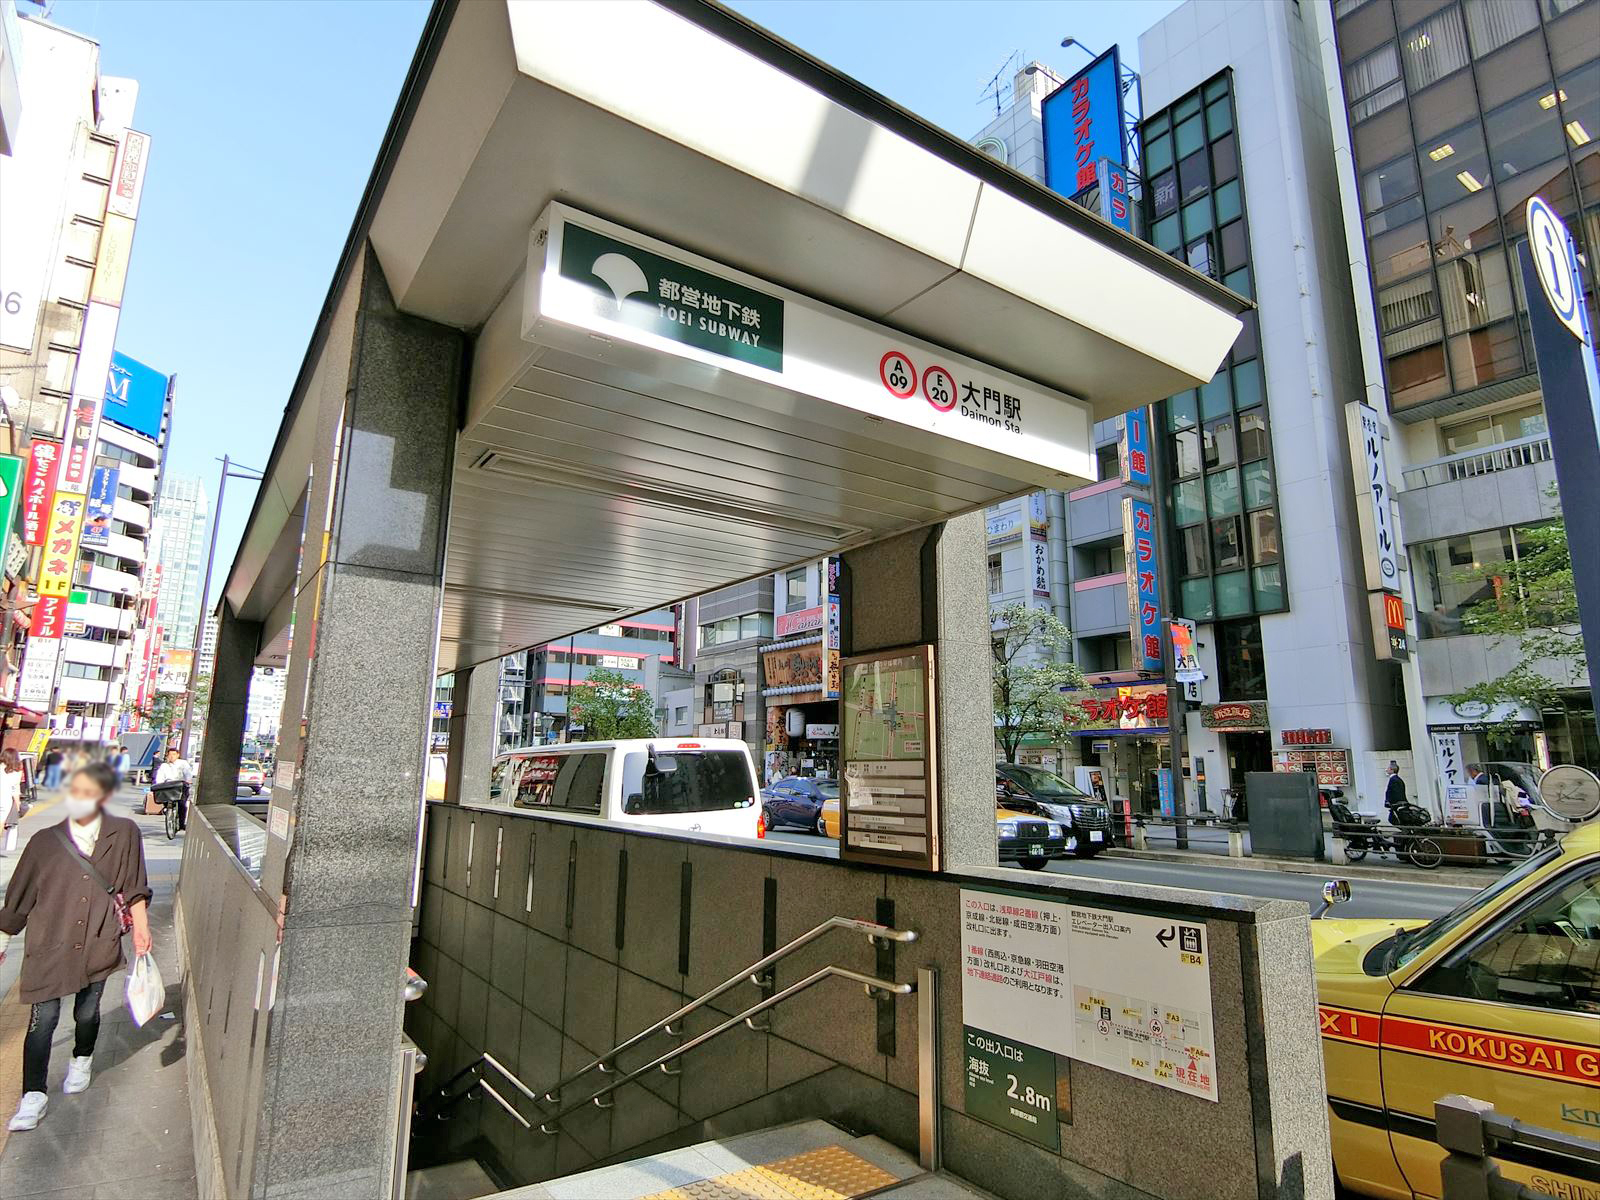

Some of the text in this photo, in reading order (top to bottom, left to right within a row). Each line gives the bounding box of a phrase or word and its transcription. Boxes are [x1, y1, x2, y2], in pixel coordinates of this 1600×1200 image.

[1071, 76, 1098, 194] カラオケ館
[1110, 171, 1127, 219] カラ
[0, 292, 22, 314] 6
[658, 278, 761, 329] 都営地下鉄
[658, 303, 761, 348] TOEI SUBWAY
[890, 373, 908, 389] 09
[894, 360, 904, 374] A
[937, 374, 943, 387] E
[931, 387, 948, 403] 20
[961, 381, 1022, 422] 大門駅
[961, 405, 1023, 435] Daimon Sta.
[1130, 410, 1147, 475] ー館
[1366, 437, 1392, 552] ルノアール
[987, 520, 1014, 535] ひまわり
[47, 519, 75, 576] メガネ
[45, 580, 66, 590] 1F
[1136, 509, 1162, 660] カラオケ館
[39, 597, 60, 636] アイフル
[1177, 654, 1198, 668] 大門
[163, 669, 188, 682] 大門
[1064, 693, 1168, 721] ラオケ館
[966, 922, 1012, 939] 改札口に出ます。
[1190, 954, 1201, 965] B4
[967, 1033, 1024, 1062] この出入口は
[1429, 1029, 1563, 1072] KOKUSAI
[968, 1056, 990, 1077] 海抜
[1175, 1066, 1210, 1086] 現在地
[1007, 1073, 1051, 1112] 2.8m
